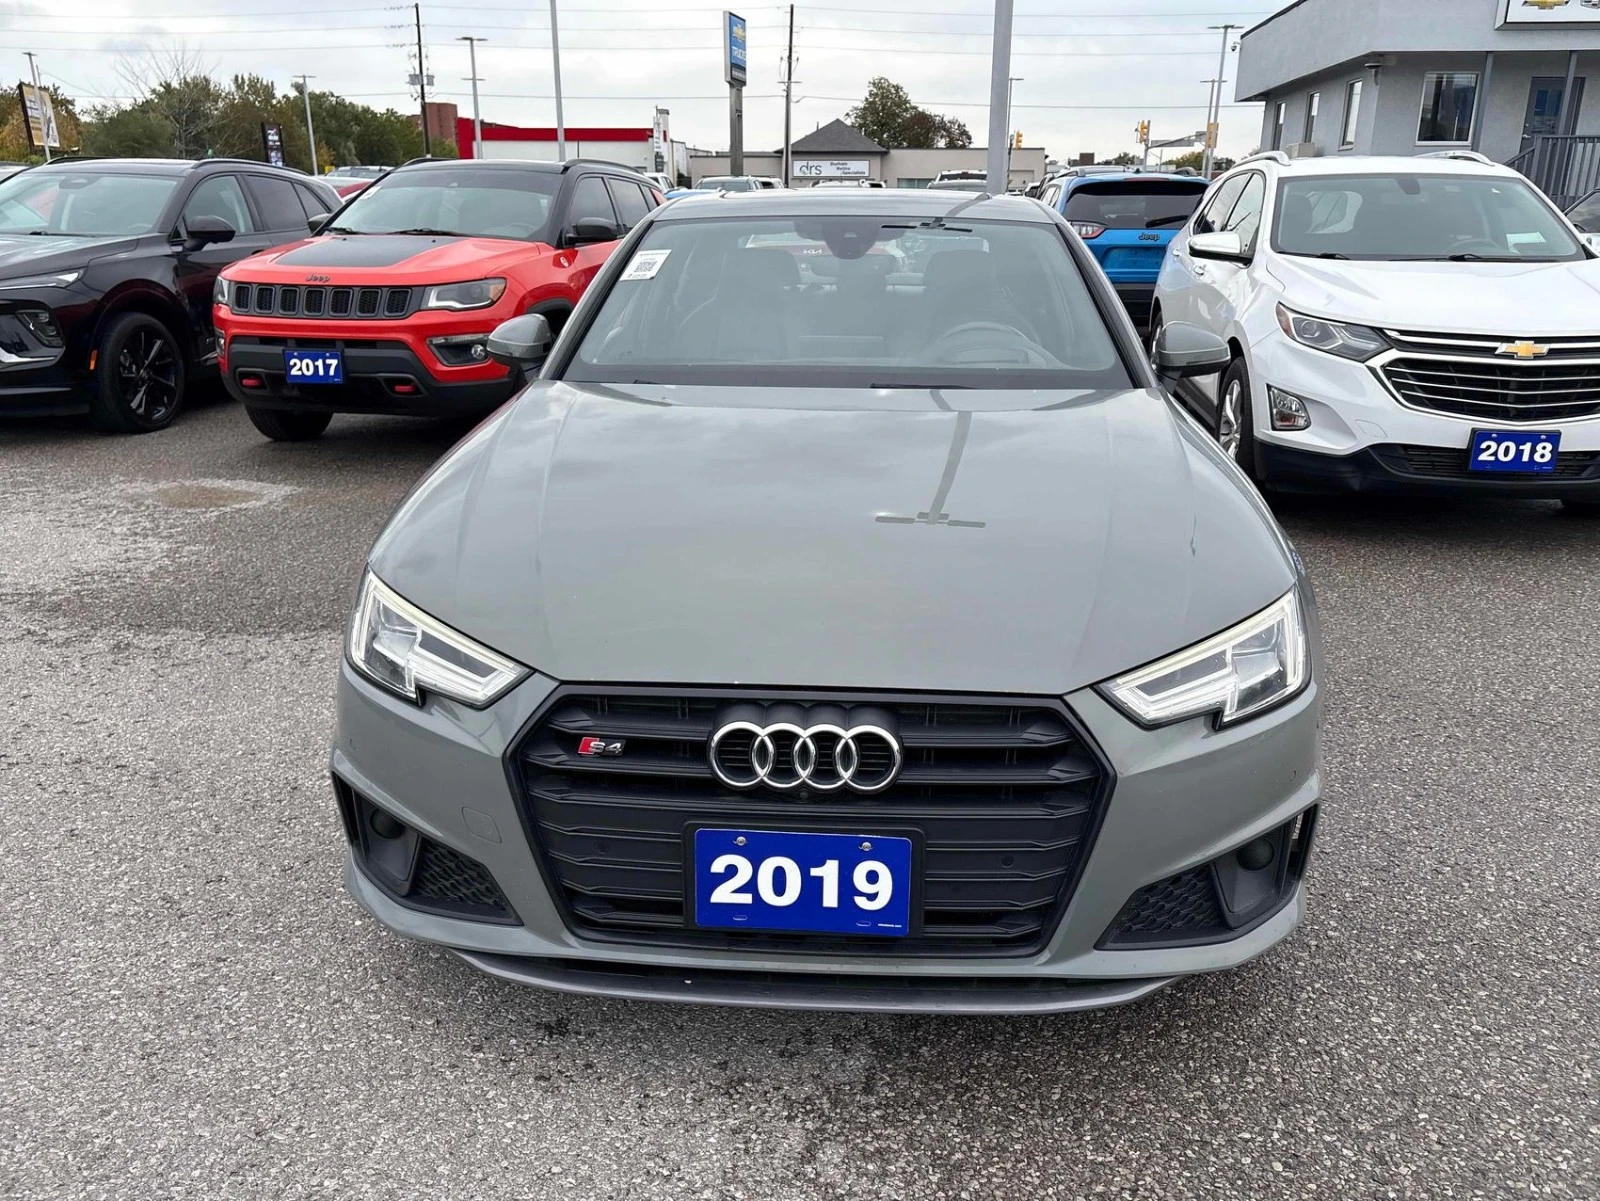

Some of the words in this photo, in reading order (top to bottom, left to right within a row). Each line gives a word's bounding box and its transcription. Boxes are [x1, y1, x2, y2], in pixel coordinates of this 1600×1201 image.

[799, 161, 823, 176] drs
[1138, 232, 1160, 242] Jeep
[305, 274, 331, 283] Jeep
[289, 358, 339, 377] 2017
[1477, 440, 1553, 463] 2018
[588, 742, 622, 754] S4
[709, 854, 894, 911] 2019
